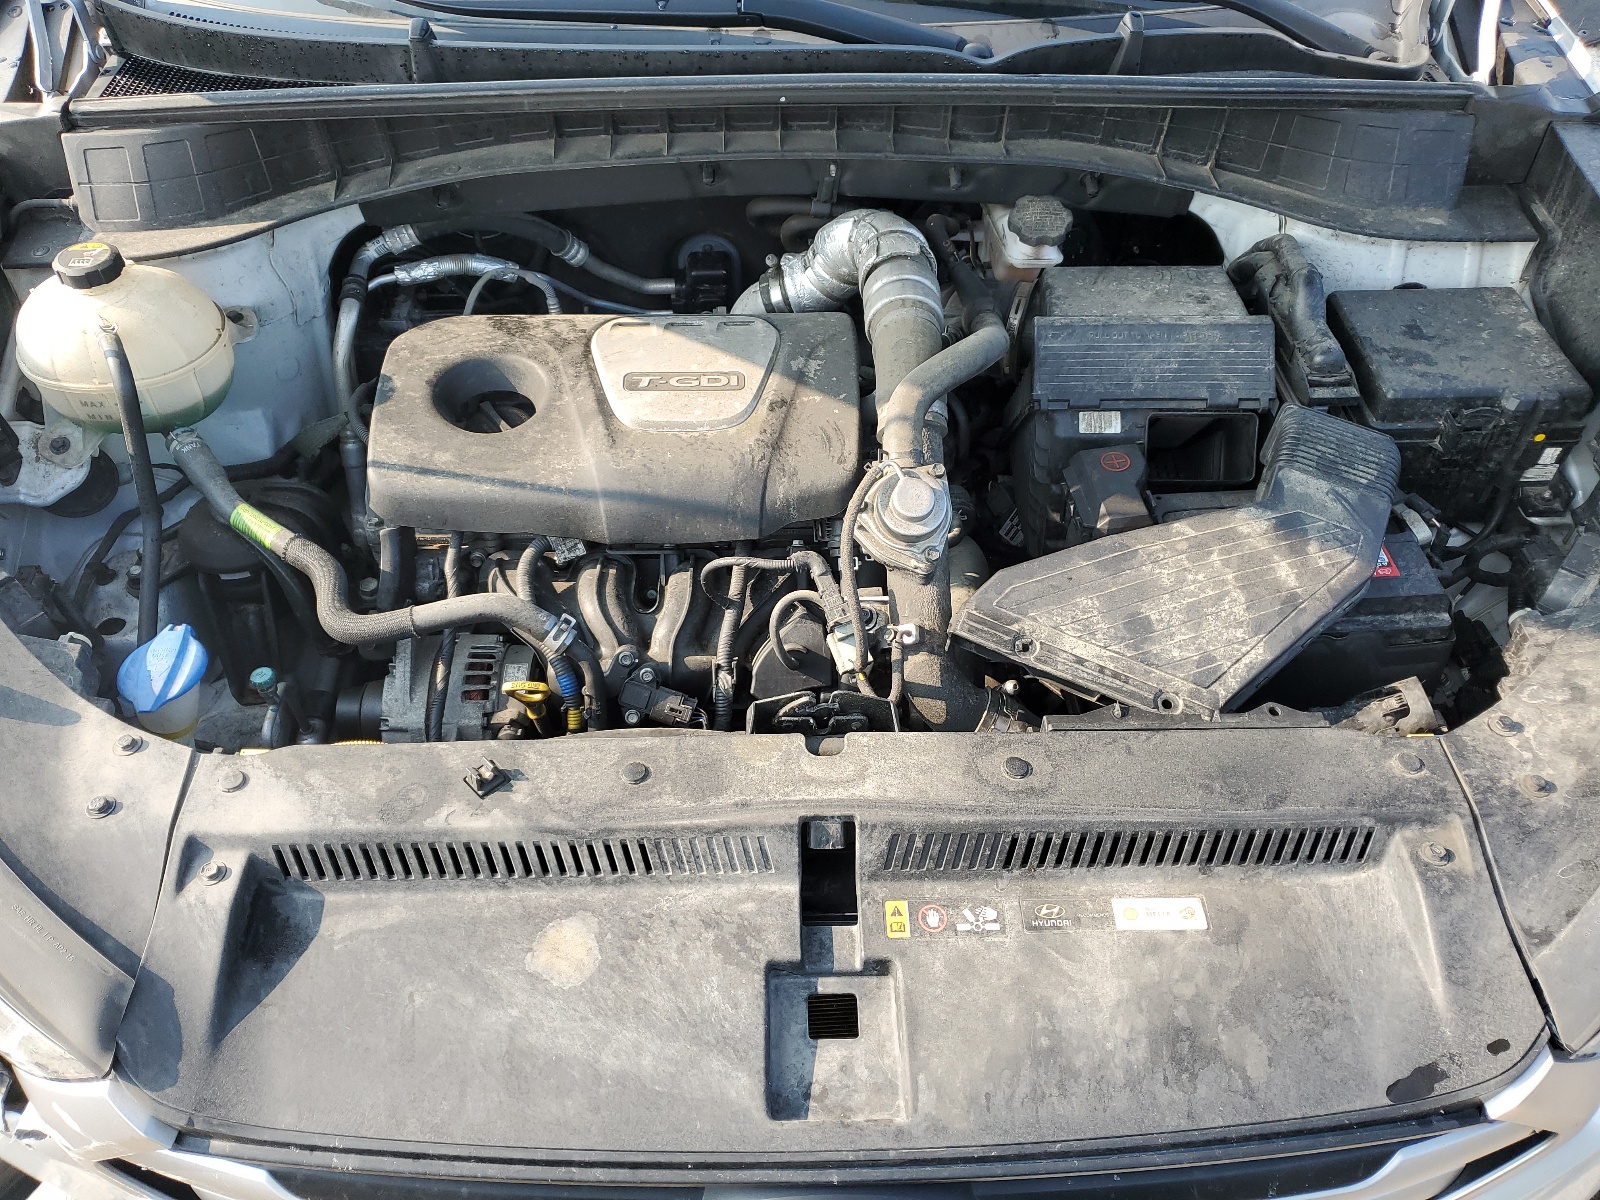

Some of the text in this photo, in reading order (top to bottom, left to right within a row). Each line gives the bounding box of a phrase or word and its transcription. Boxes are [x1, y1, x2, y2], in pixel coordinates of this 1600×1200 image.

[631, 374, 740, 388] T-GDI
[86, 413, 114, 421] MIN
[1031, 919, 1072, 927] HYUNDAI
